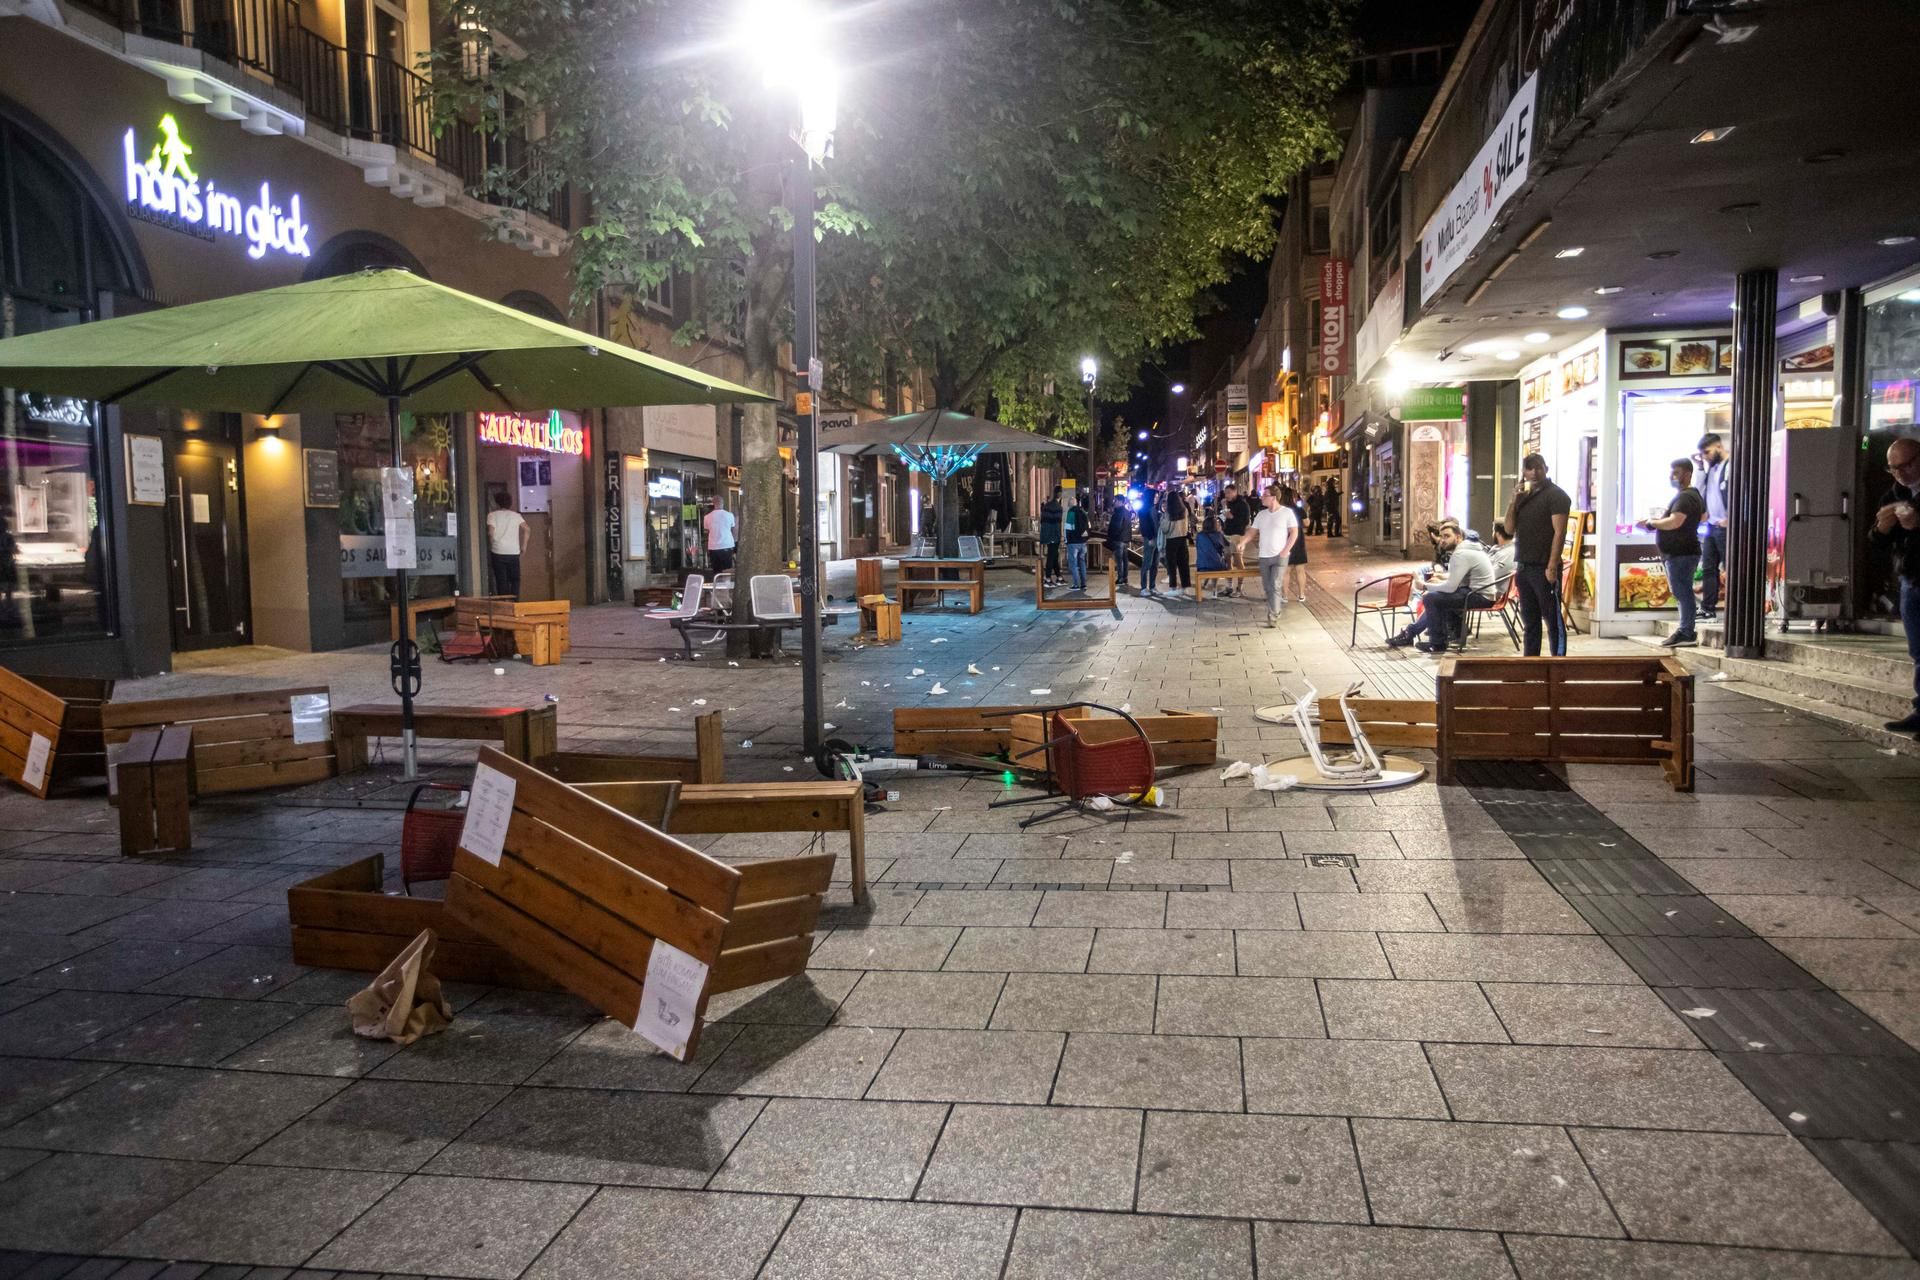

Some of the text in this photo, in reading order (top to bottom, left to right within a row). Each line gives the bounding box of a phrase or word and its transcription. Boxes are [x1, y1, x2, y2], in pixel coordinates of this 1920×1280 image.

[1494, 104, 1530, 198] SALE
[206, 180, 242, 235] im
[245, 181, 311, 259] glück
[1334, 261, 1345, 301] shoppen
[1324, 304, 1345, 371] ORION
[608, 459, 622, 569] FRISEUR
